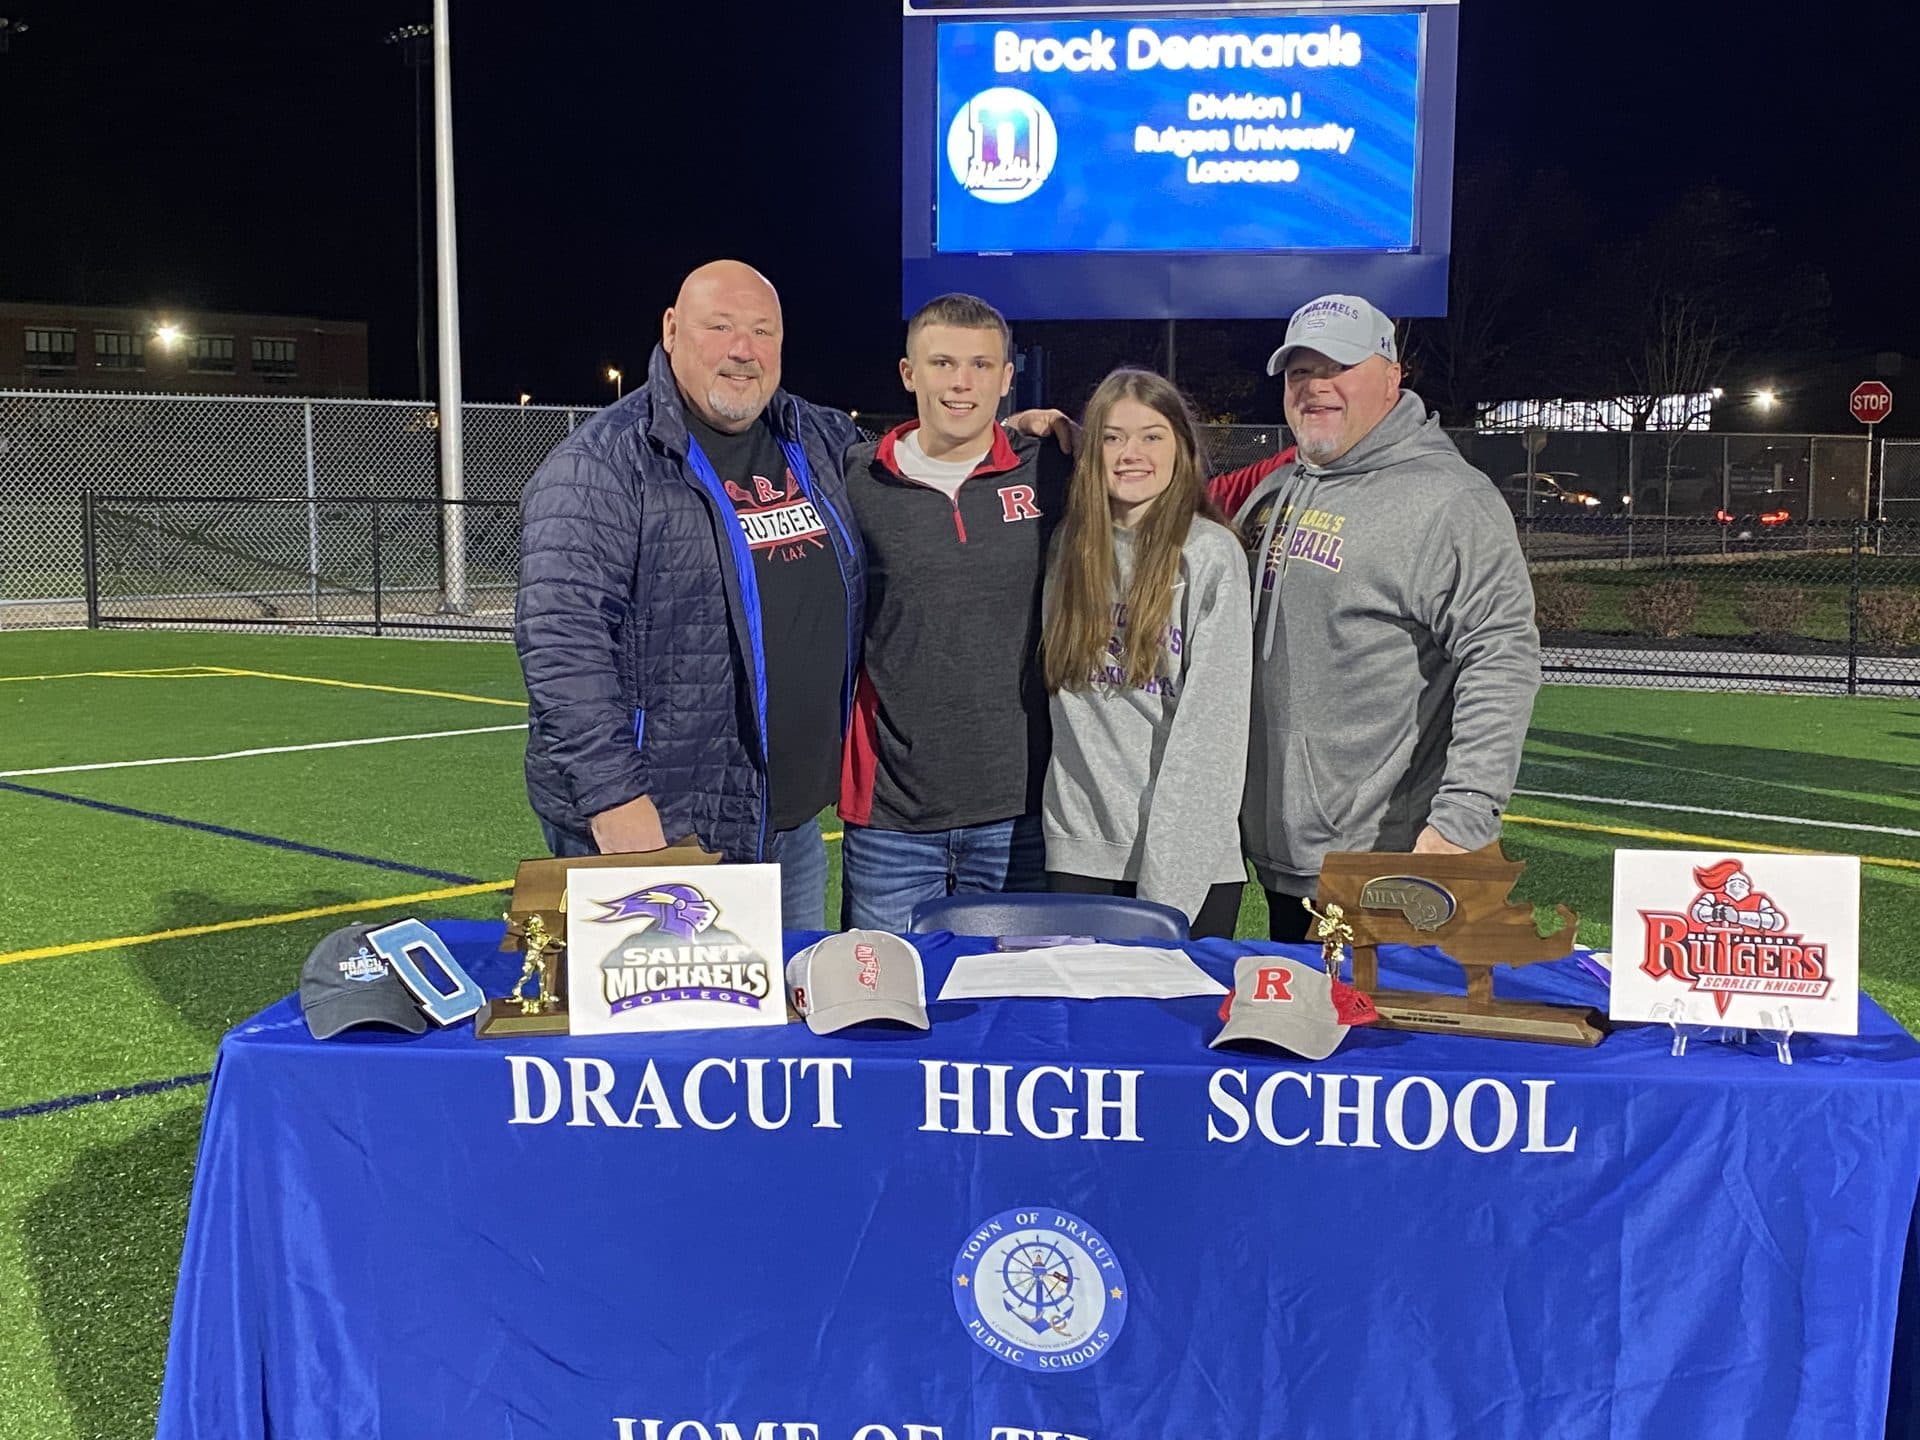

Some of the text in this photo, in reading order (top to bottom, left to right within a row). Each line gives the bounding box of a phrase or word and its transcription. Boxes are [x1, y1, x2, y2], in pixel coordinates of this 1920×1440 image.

[994, 24, 1362, 73] Brock Desmarais
[1188, 92, 1287, 120] Division
[1135, 122, 1355, 158] Rutgers University
[1187, 156, 1299, 184] Lacrosse
[1853, 394, 1889, 410] STOP
[752, 475, 784, 502] R
[997, 484, 1044, 522] R
[738, 505, 822, 541] RUTGER
[781, 544, 807, 562] LAX
[623, 944, 750, 966] SAINT
[604, 962, 768, 1004] MICHAEL'S
[794, 987, 808, 1009] R
[1252, 966, 1294, 1002] R
[1703, 976, 1823, 994] SCARLET KNIGHTS
[621, 991, 750, 1010] COLLEGE
[505, 1055, 1579, 1154] DRACUT HIGH SCHOOL
[962, 1212, 1116, 1270] TOWN OF DRACUT
[969, 1319, 1025, 1362] PUBLIC
[1039, 1330, 1111, 1368] SCHOOLS
